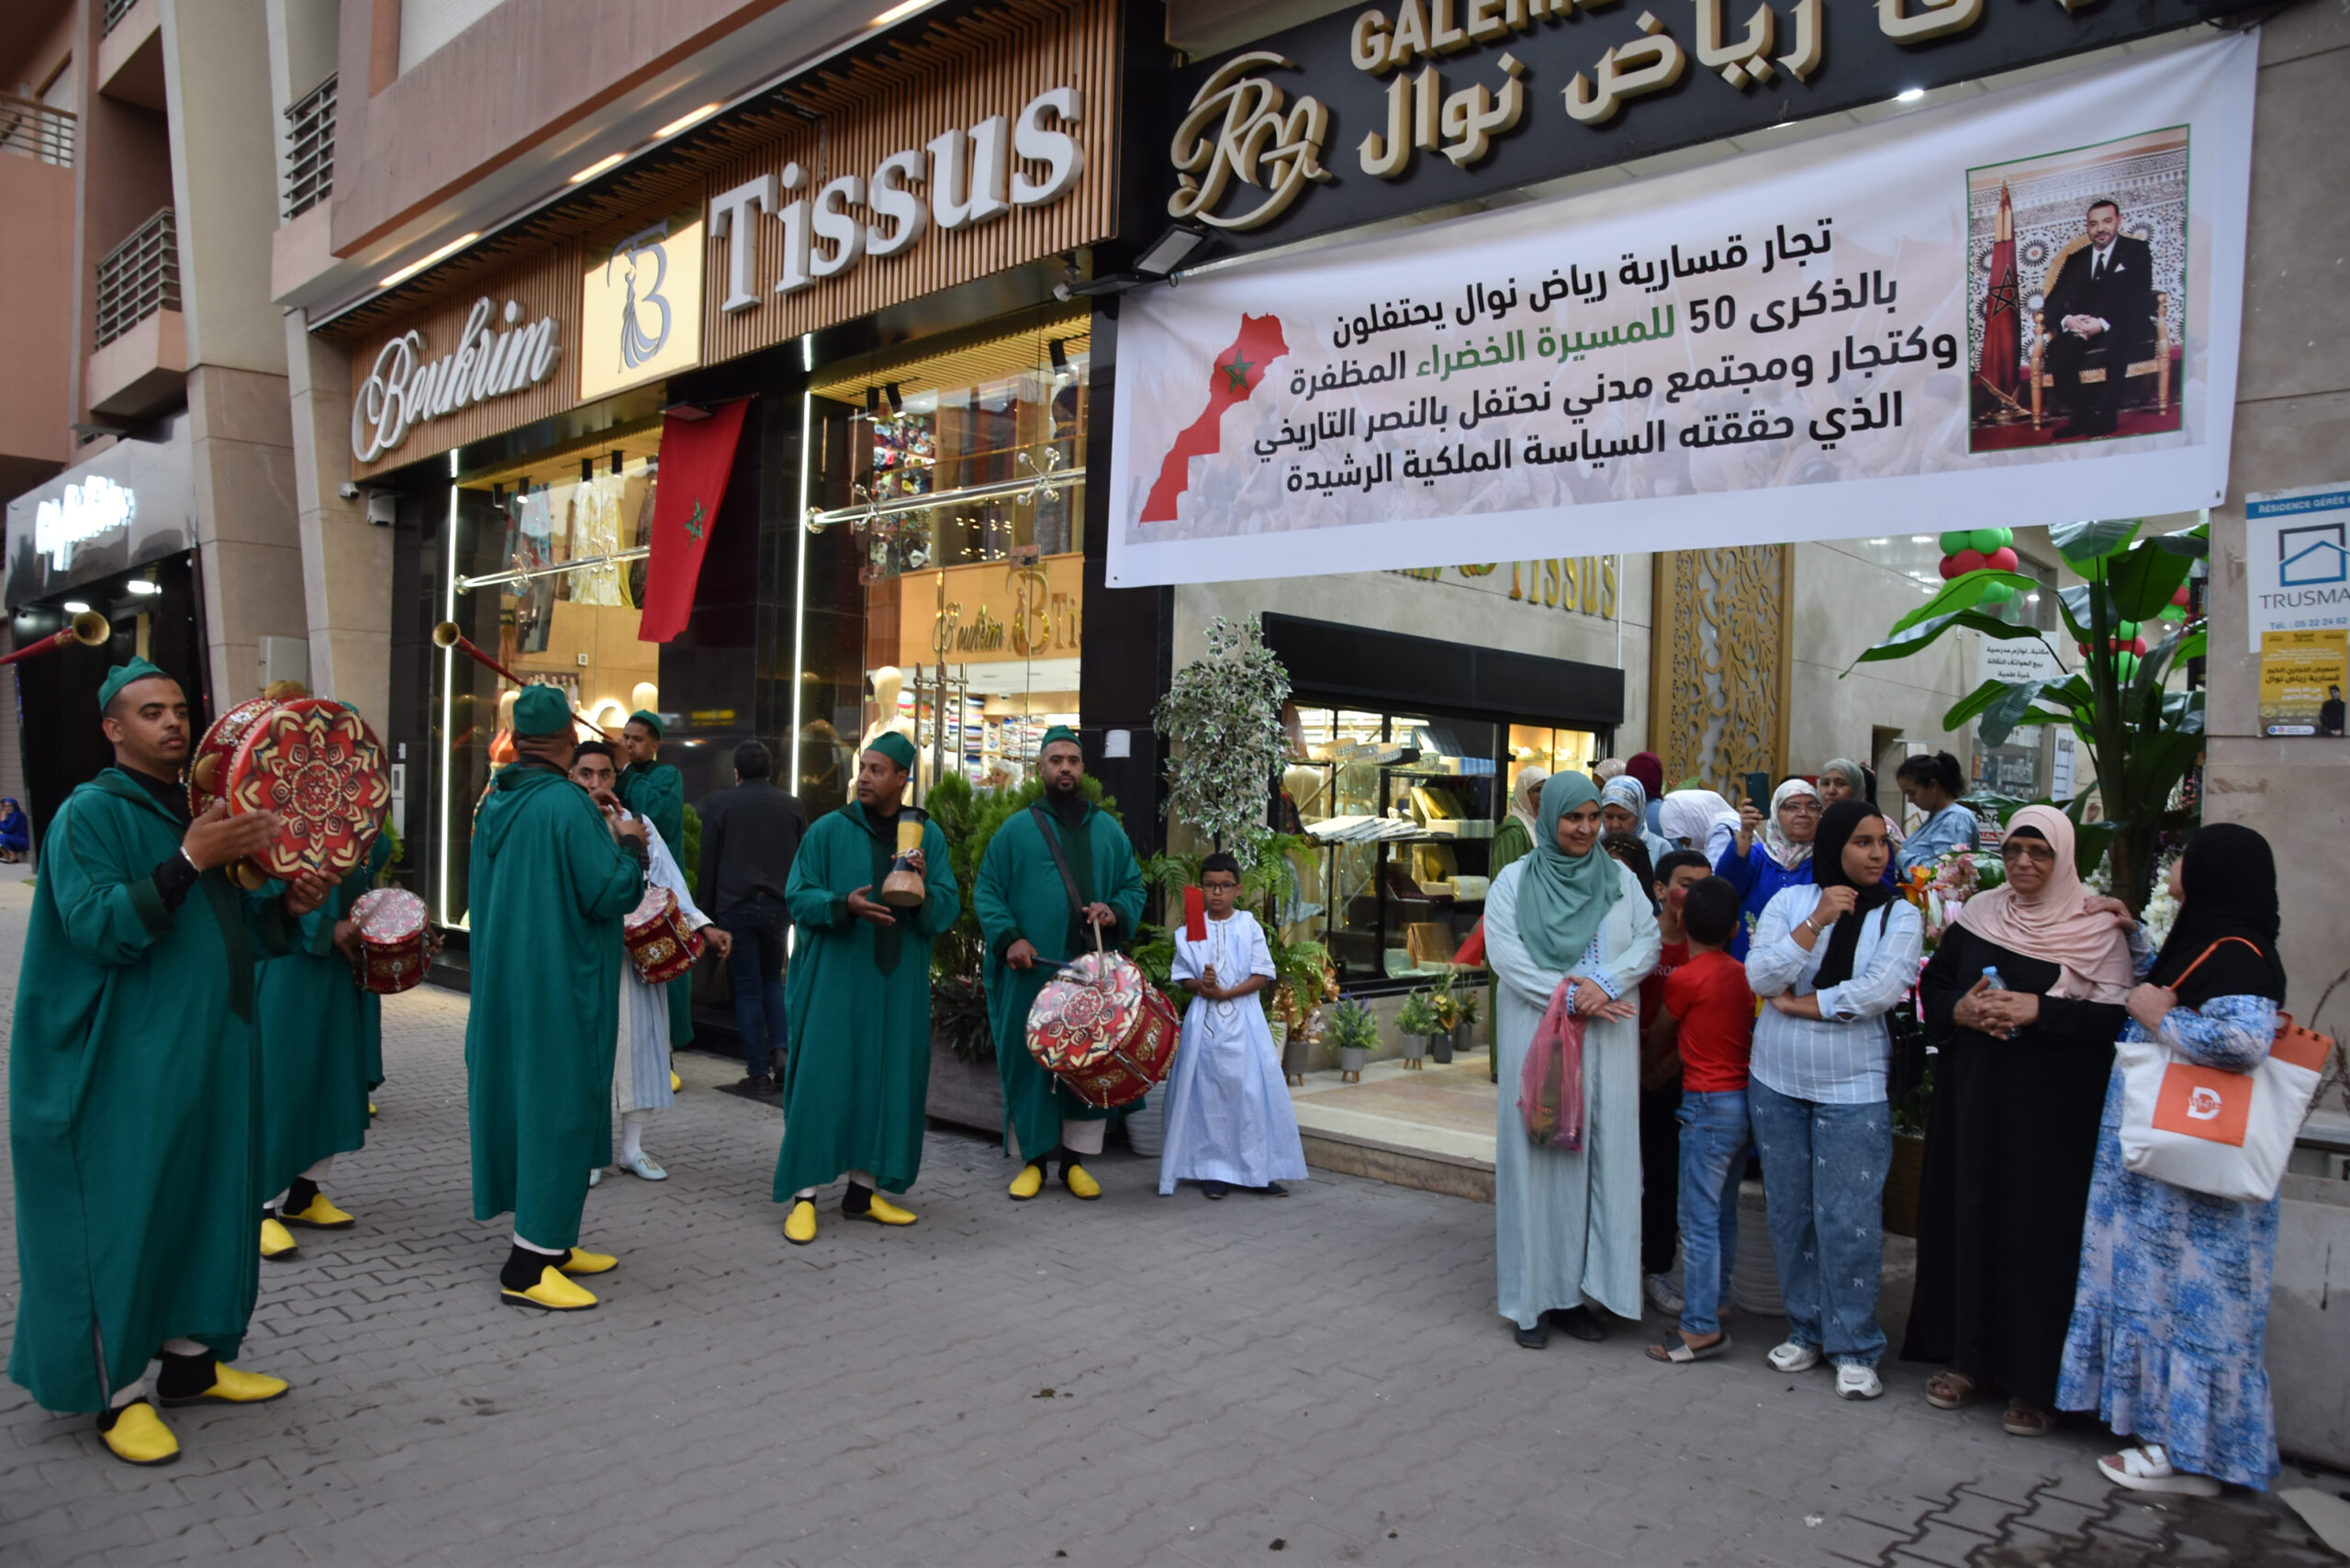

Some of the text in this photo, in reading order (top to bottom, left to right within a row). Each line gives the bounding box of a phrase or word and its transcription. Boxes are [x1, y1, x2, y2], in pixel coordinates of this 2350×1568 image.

[1350, 0, 1602, 73] GALE
[1357, 0, 1823, 178] رياض نوال
[711, 86, 1084, 314] Tissus
[1290, 269, 1897, 401] بالذكرى 50 للمسيرة الخضراء المظفرة
[1333, 217, 1833, 348] تجار قسارية رياض نوال يحتفلون
[352, 296, 563, 463] Boukrim
[1254, 325, 1957, 464] وكتجار ومجتمع مدني نحتفل بالنصر التاريخي
[1286, 389, 1903, 498] الذي حققته السياسة الملكية الرشيدة
[2258, 499, 2311, 514] RÉSIDENCE
